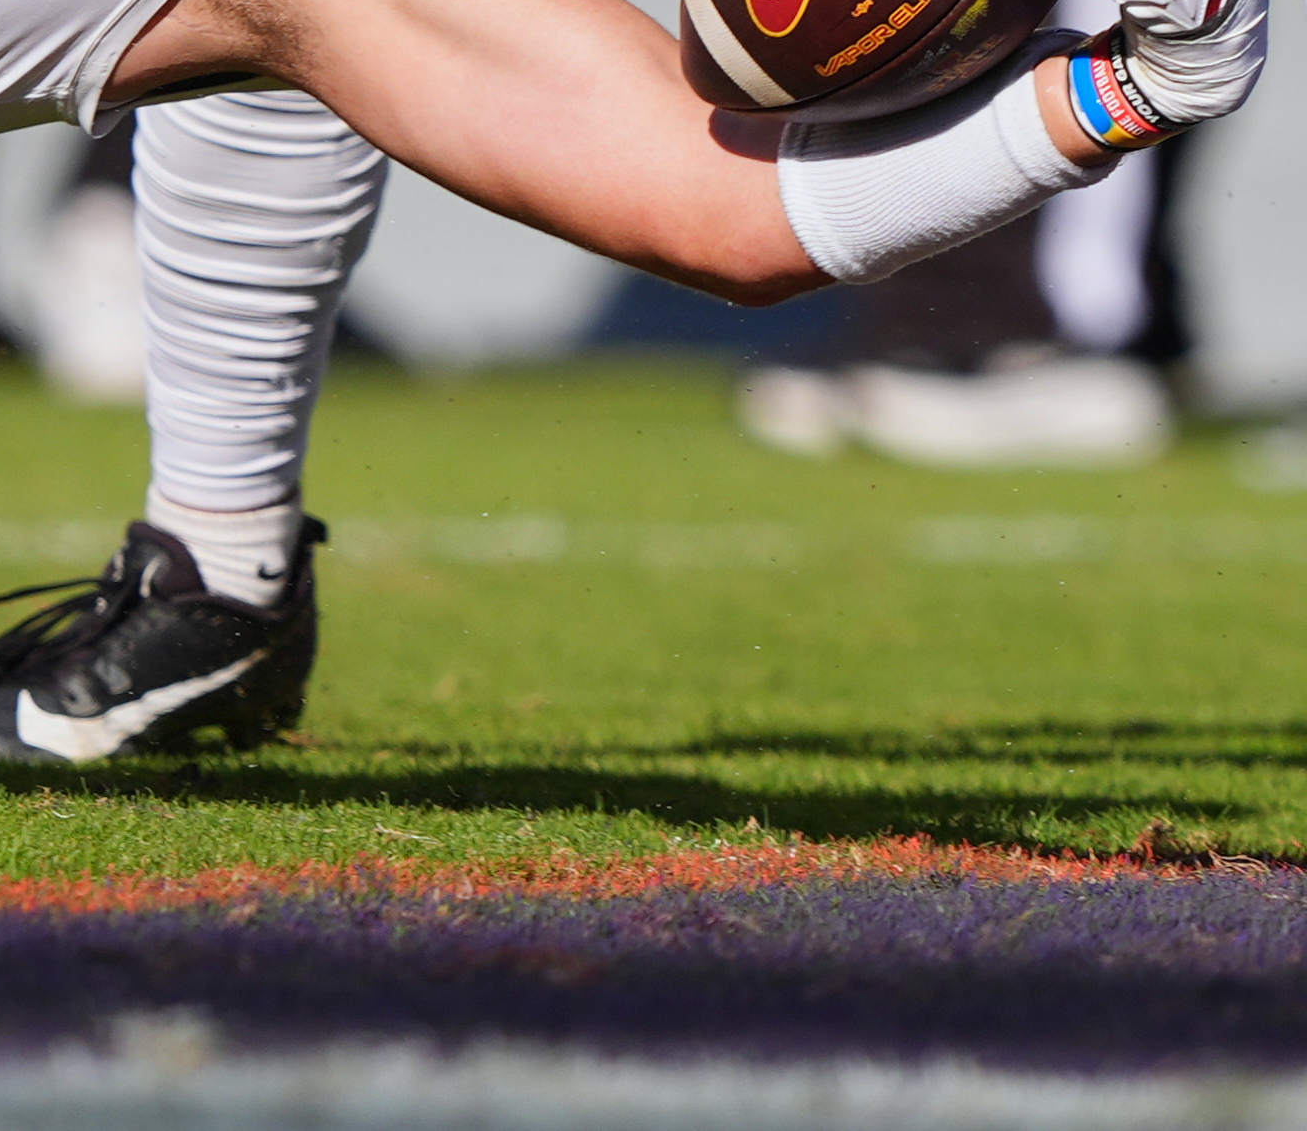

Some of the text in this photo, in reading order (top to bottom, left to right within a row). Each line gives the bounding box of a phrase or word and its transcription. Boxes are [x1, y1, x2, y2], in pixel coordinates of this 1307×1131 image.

[814, 23, 898, 77] VAPOR
[1122, 82, 1161, 124] YOUR
[1118, 114, 1146, 136] ONE
